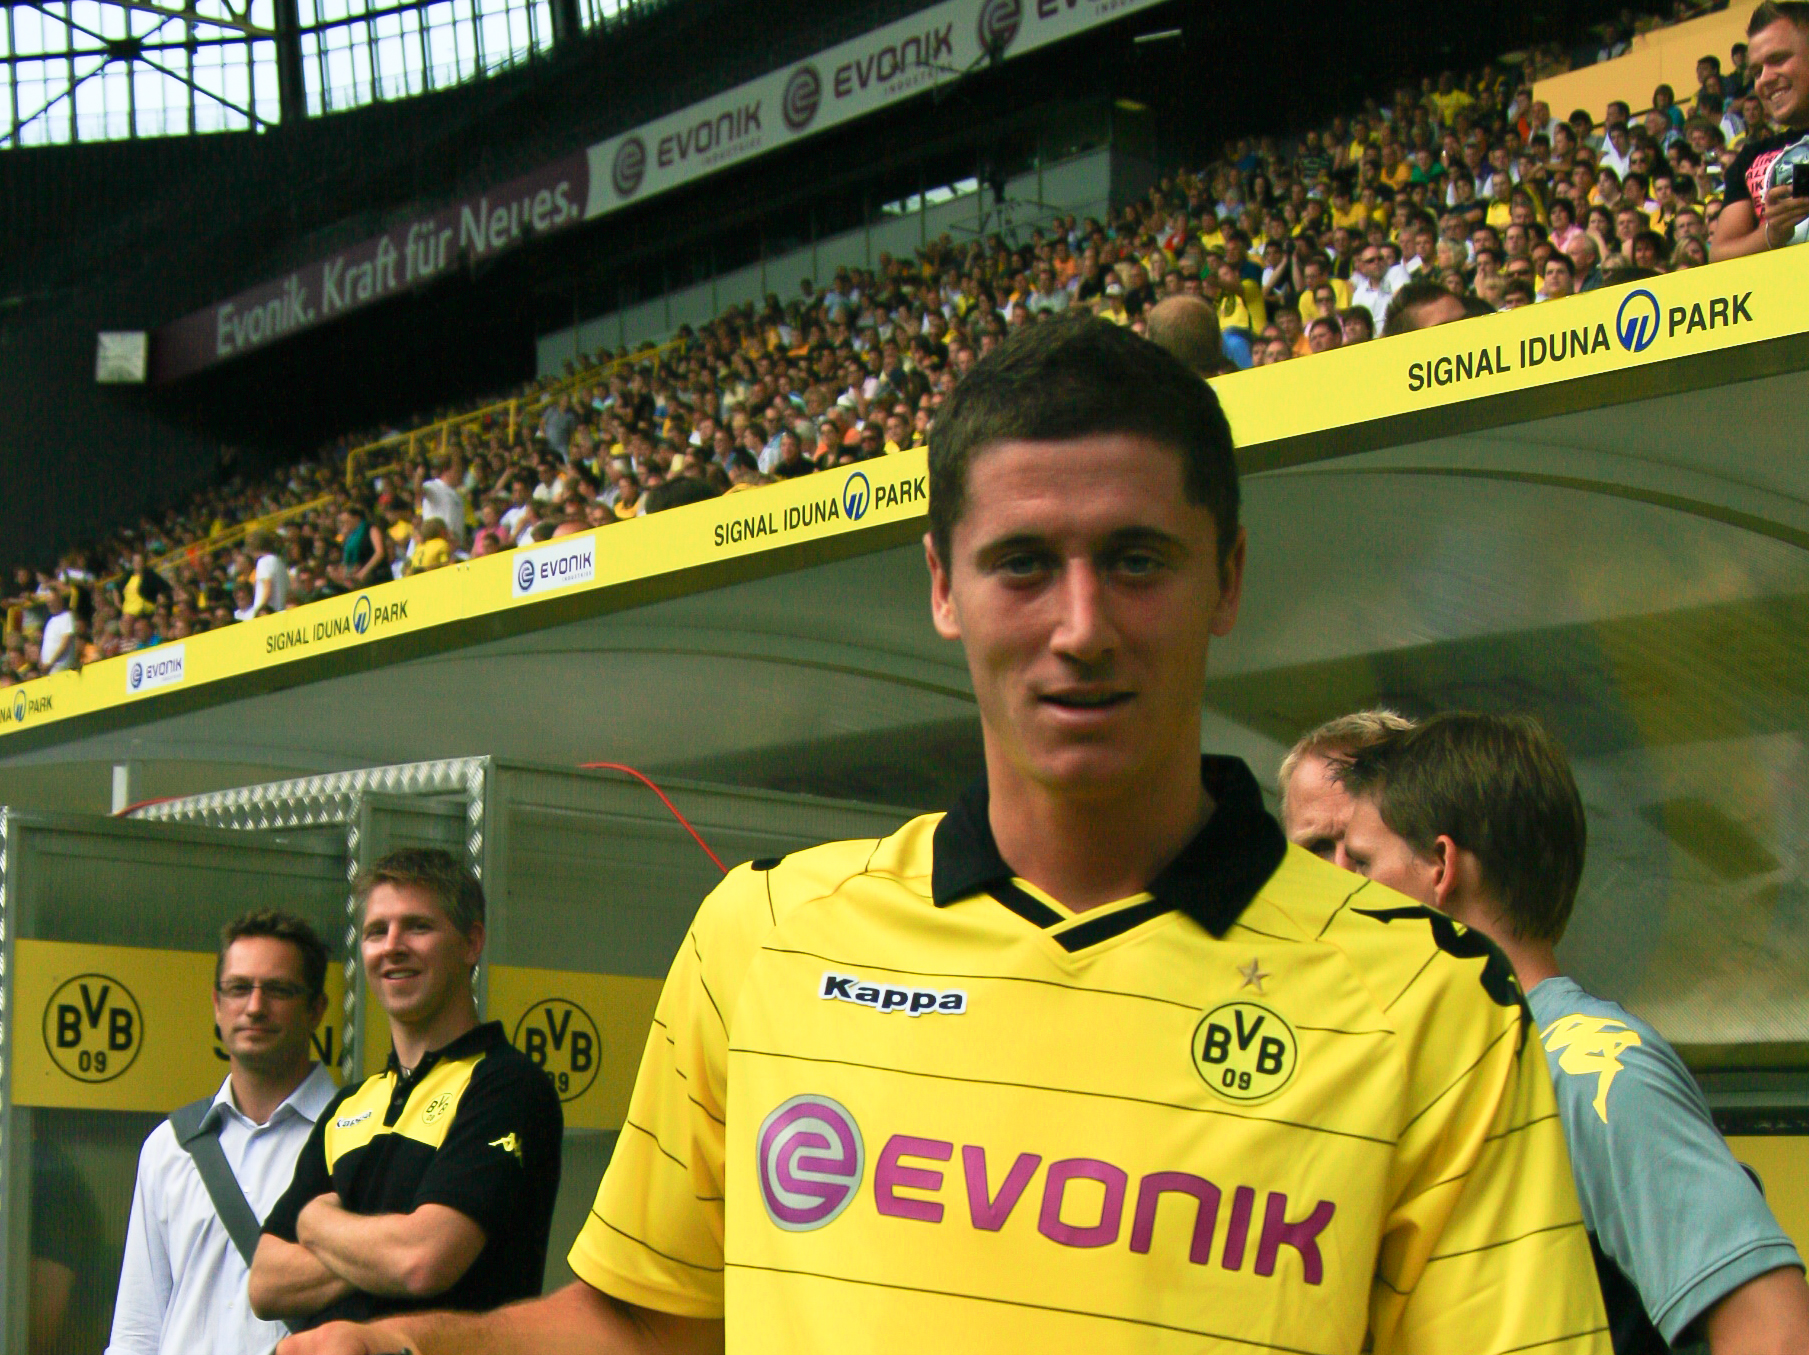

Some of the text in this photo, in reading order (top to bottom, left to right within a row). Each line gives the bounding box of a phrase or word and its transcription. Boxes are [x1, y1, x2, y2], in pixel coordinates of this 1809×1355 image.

[834, 22, 952, 98] EVONIK
[657, 100, 762, 168] EVONIK
[216, 274, 316, 356] Evonik.
[322, 235, 397, 313] Kraft
[405, 220, 451, 283] für
[1408, 291, 1753, 392] SIGNAL IDUNA PARK
[714, 476, 926, 546] SIGNAL IDUNA PARK
[540, 552, 592, 579] EVONIK
[266, 600, 408, 653] SIGNAL IDUNA PARK
[146, 657, 182, 679] EVONIK
[28, 694, 53, 715] PARK
[57, 983, 133, 1051] BVB
[824, 976, 963, 1013] Kappa
[78, 1050, 107, 1073] 09
[526, 1008, 592, 1072] BVB
[1202, 1009, 1285, 1075] BVB
[1222, 1068, 1251, 1090] 09
[874, 1134, 1336, 1286] EVONIK
